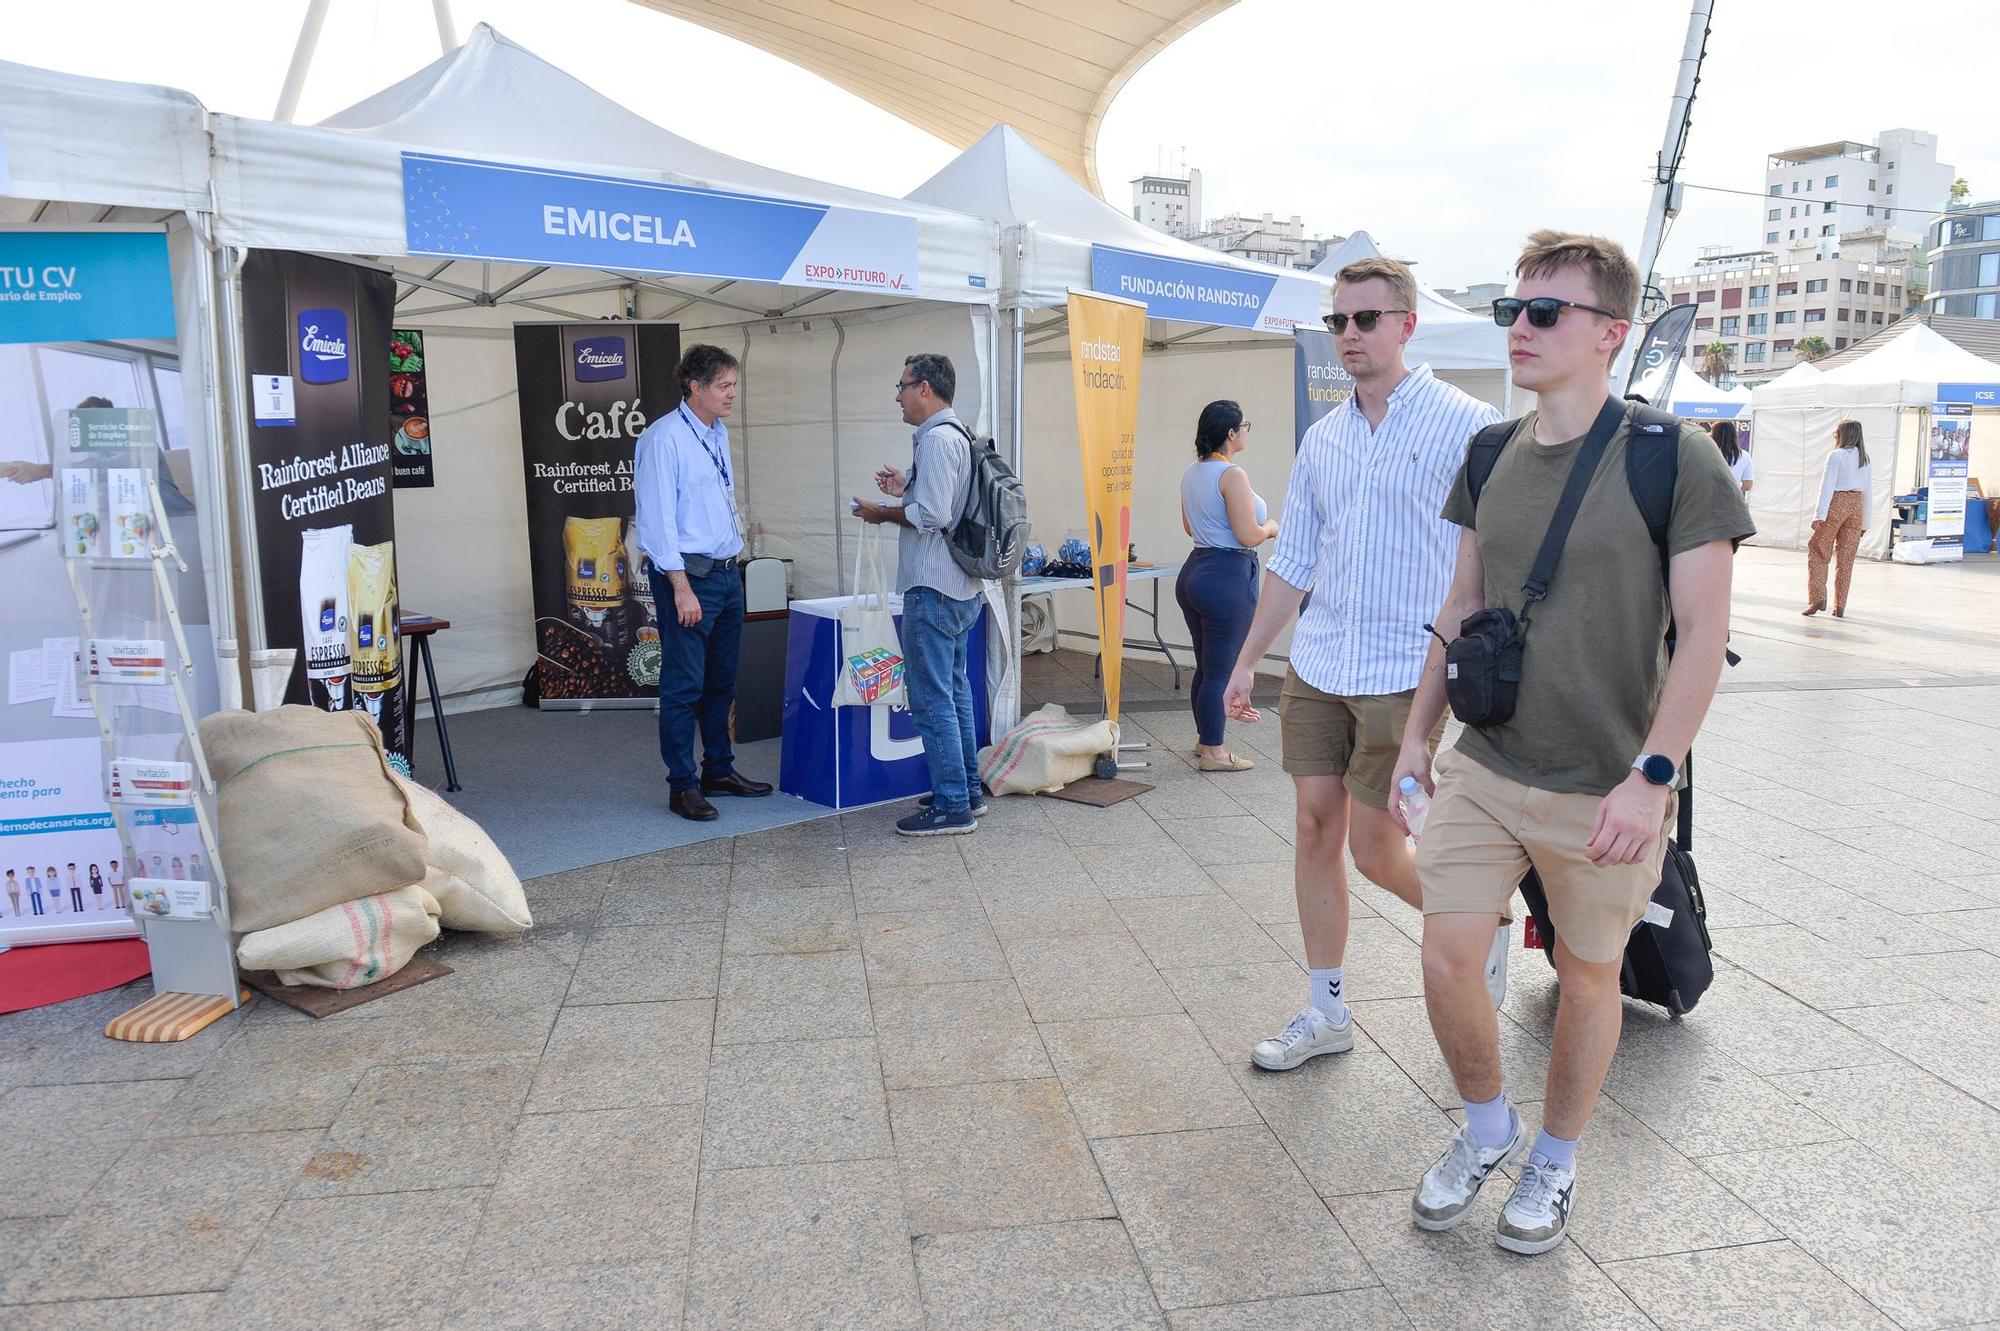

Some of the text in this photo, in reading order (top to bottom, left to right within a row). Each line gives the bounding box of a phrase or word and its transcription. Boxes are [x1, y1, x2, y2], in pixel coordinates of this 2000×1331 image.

[543, 204, 697, 248] EMICELA
[0, 266, 76, 288] TU CV
[805, 265, 835, 279] EXPO
[844, 268, 886, 284] FUTURO
[22, 291, 37, 301] de
[39, 291, 82, 303] Empleo
[1120, 274, 1260, 309] FUNDACIÓN RANDSTAD
[303, 325, 347, 357] Emicela
[578, 347, 624, 365] Emicela
[1975, 391, 1996, 400] ICSE
[555, 398, 647, 441] Café
[258, 442, 390, 491] Rainforest Alliance
[394, 466, 411, 476] buen
[411, 464, 426, 476] café
[533, 461, 611, 478] Rainforest
[553, 477, 617, 494] Certified
[281, 475, 386, 521] Certified Beans
[570, 585, 607, 597] ESPRESSO
[112, 644, 149, 656] Invitación
[311, 642, 346, 661] ESPRESSO
[0, 778, 36, 789] hecho
[0, 786, 62, 800] enta para
